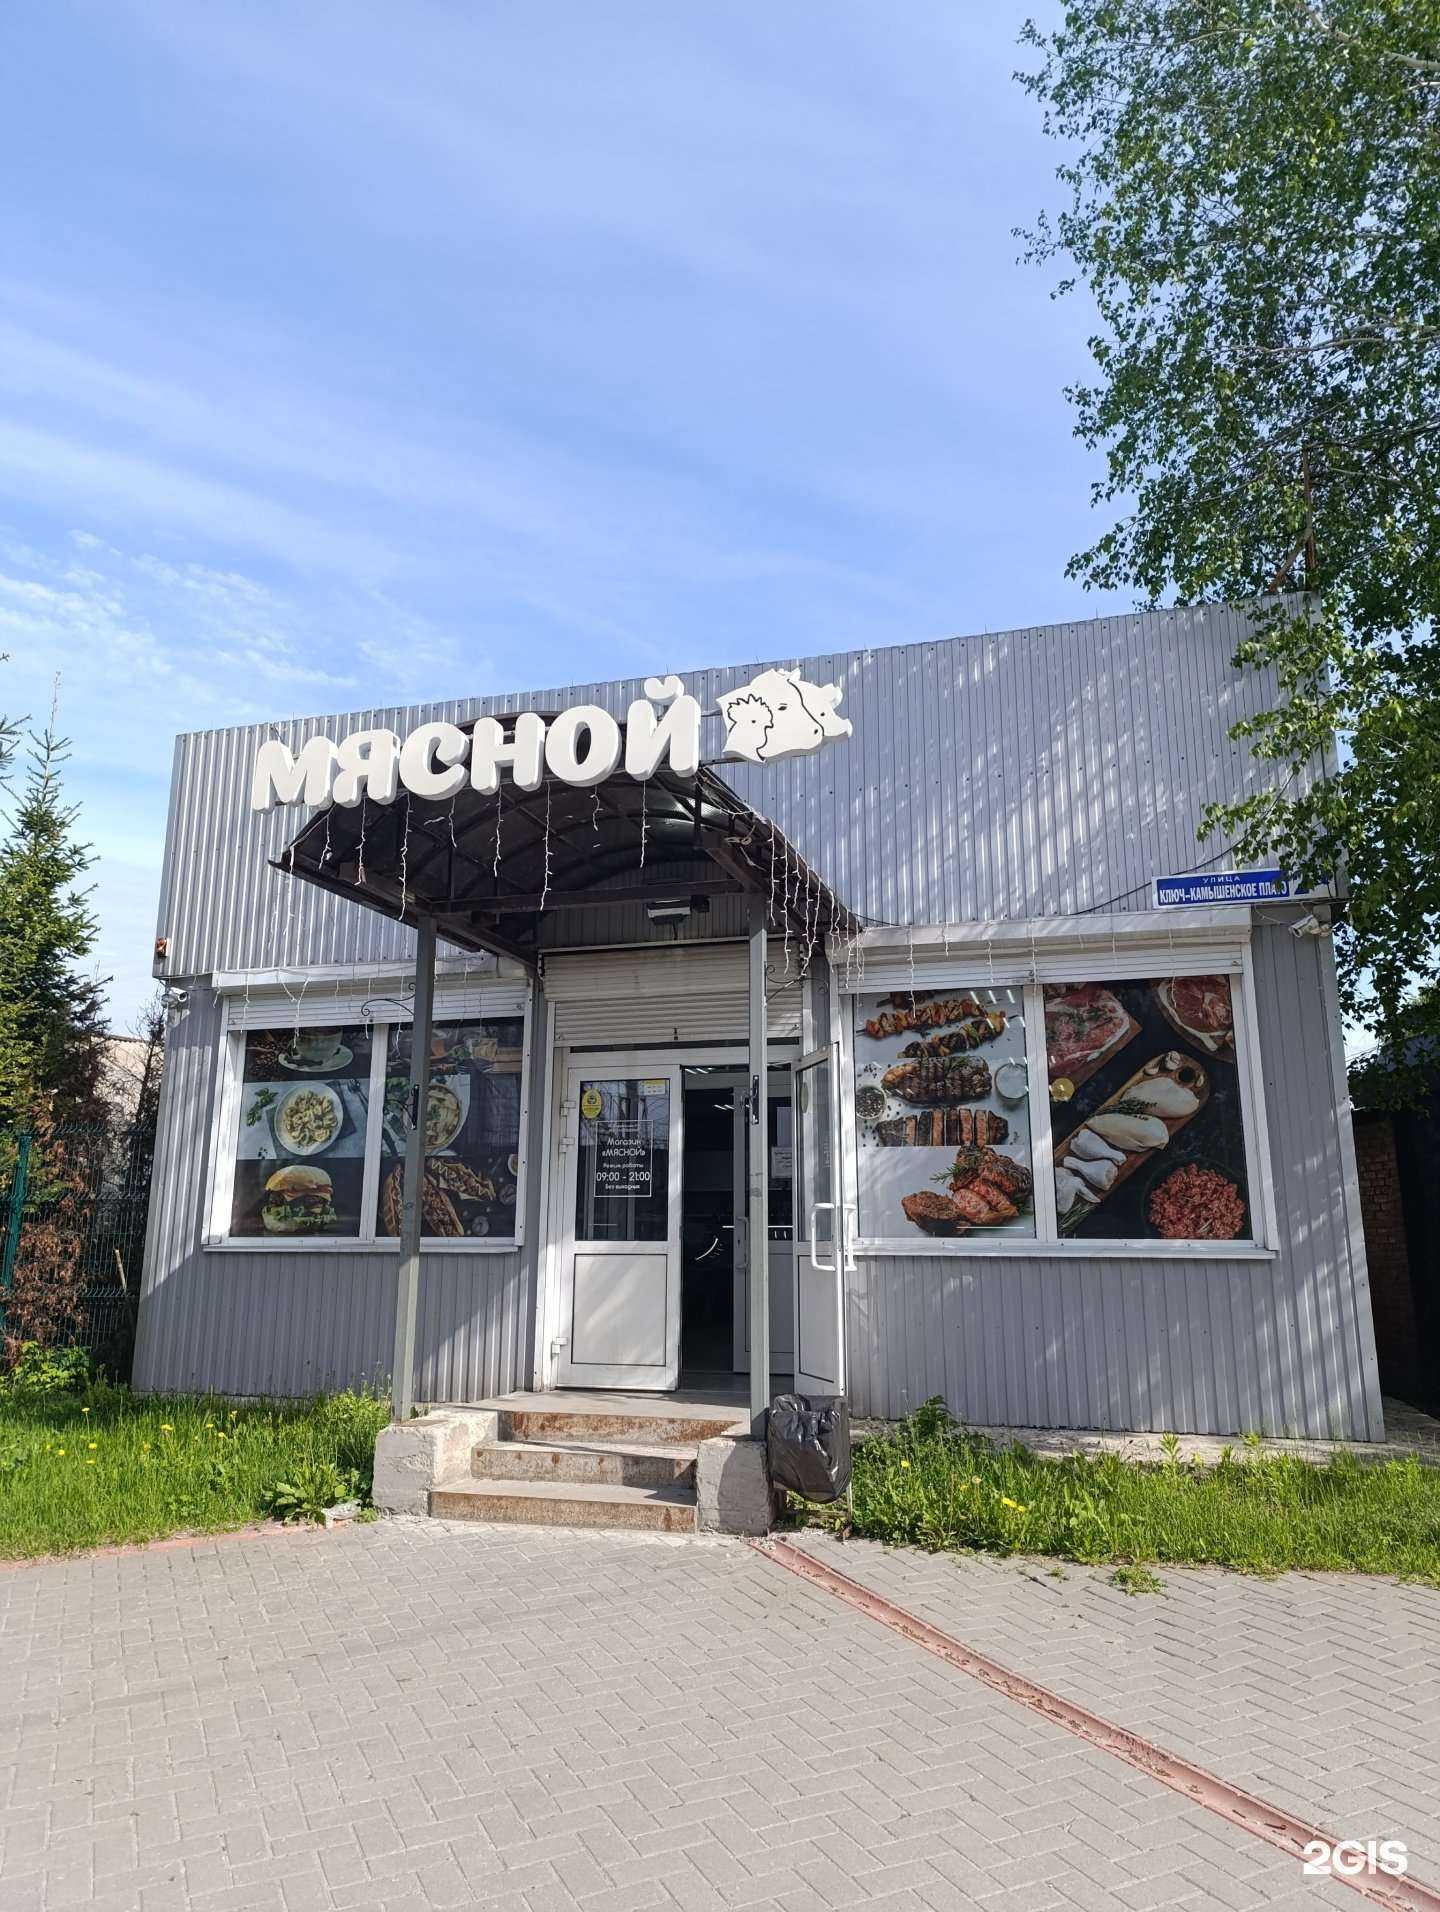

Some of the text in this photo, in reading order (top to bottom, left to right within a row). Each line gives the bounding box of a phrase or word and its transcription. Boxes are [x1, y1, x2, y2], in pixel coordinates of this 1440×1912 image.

[251, 675, 702, 814] МЯСНОЙ
[1202, 876, 1241, 884] УЛИЦА
[1160, 881, 1287, 903] КЛЮЧ-КАМЫШЕНСКОЕ ПЛАО
[602, 1147, 645, 1156] «МЯСНОЙ»
[596, 1172, 619, 1181] 09:00
[629, 1172, 650, 1181] 21:00
